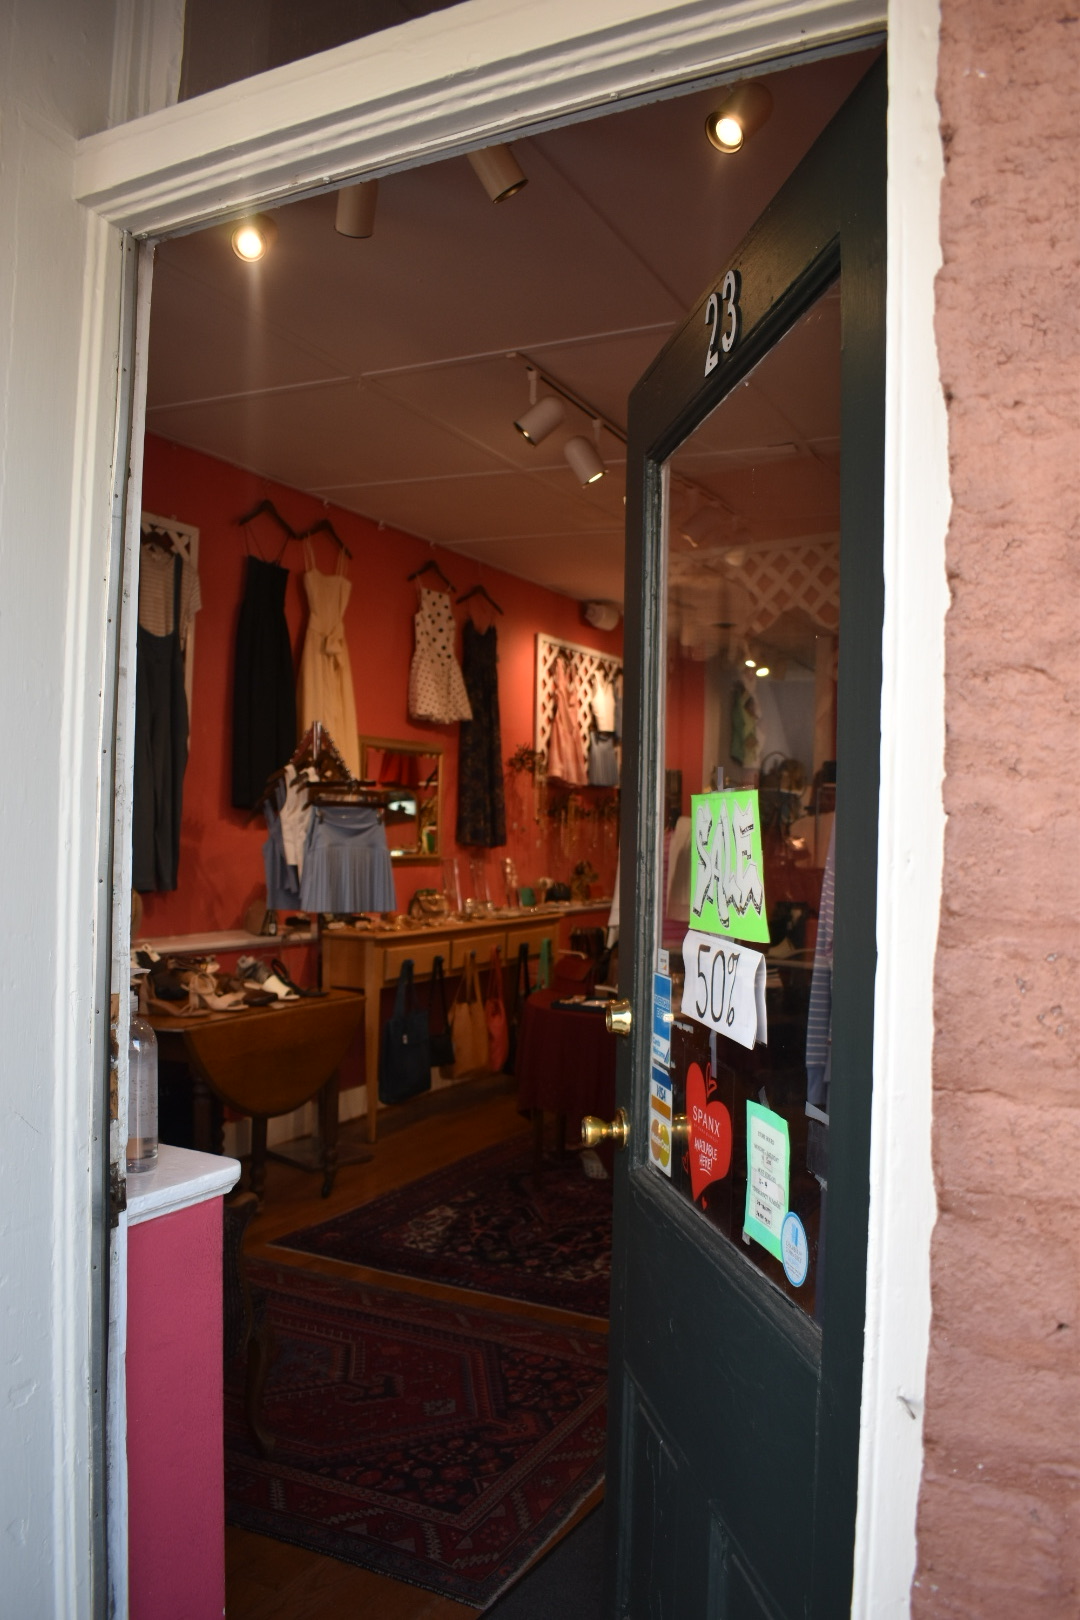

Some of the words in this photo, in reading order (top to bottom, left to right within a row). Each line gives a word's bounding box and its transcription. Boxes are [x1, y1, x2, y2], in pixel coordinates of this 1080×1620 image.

[704, 270, 741, 377] 23
[692, 798, 763, 930] SALE
[696, 944, 740, 1027] 50%
[693, 1105, 720, 1137] SPANX
[694, 1137, 718, 1161] AVAILABLE
